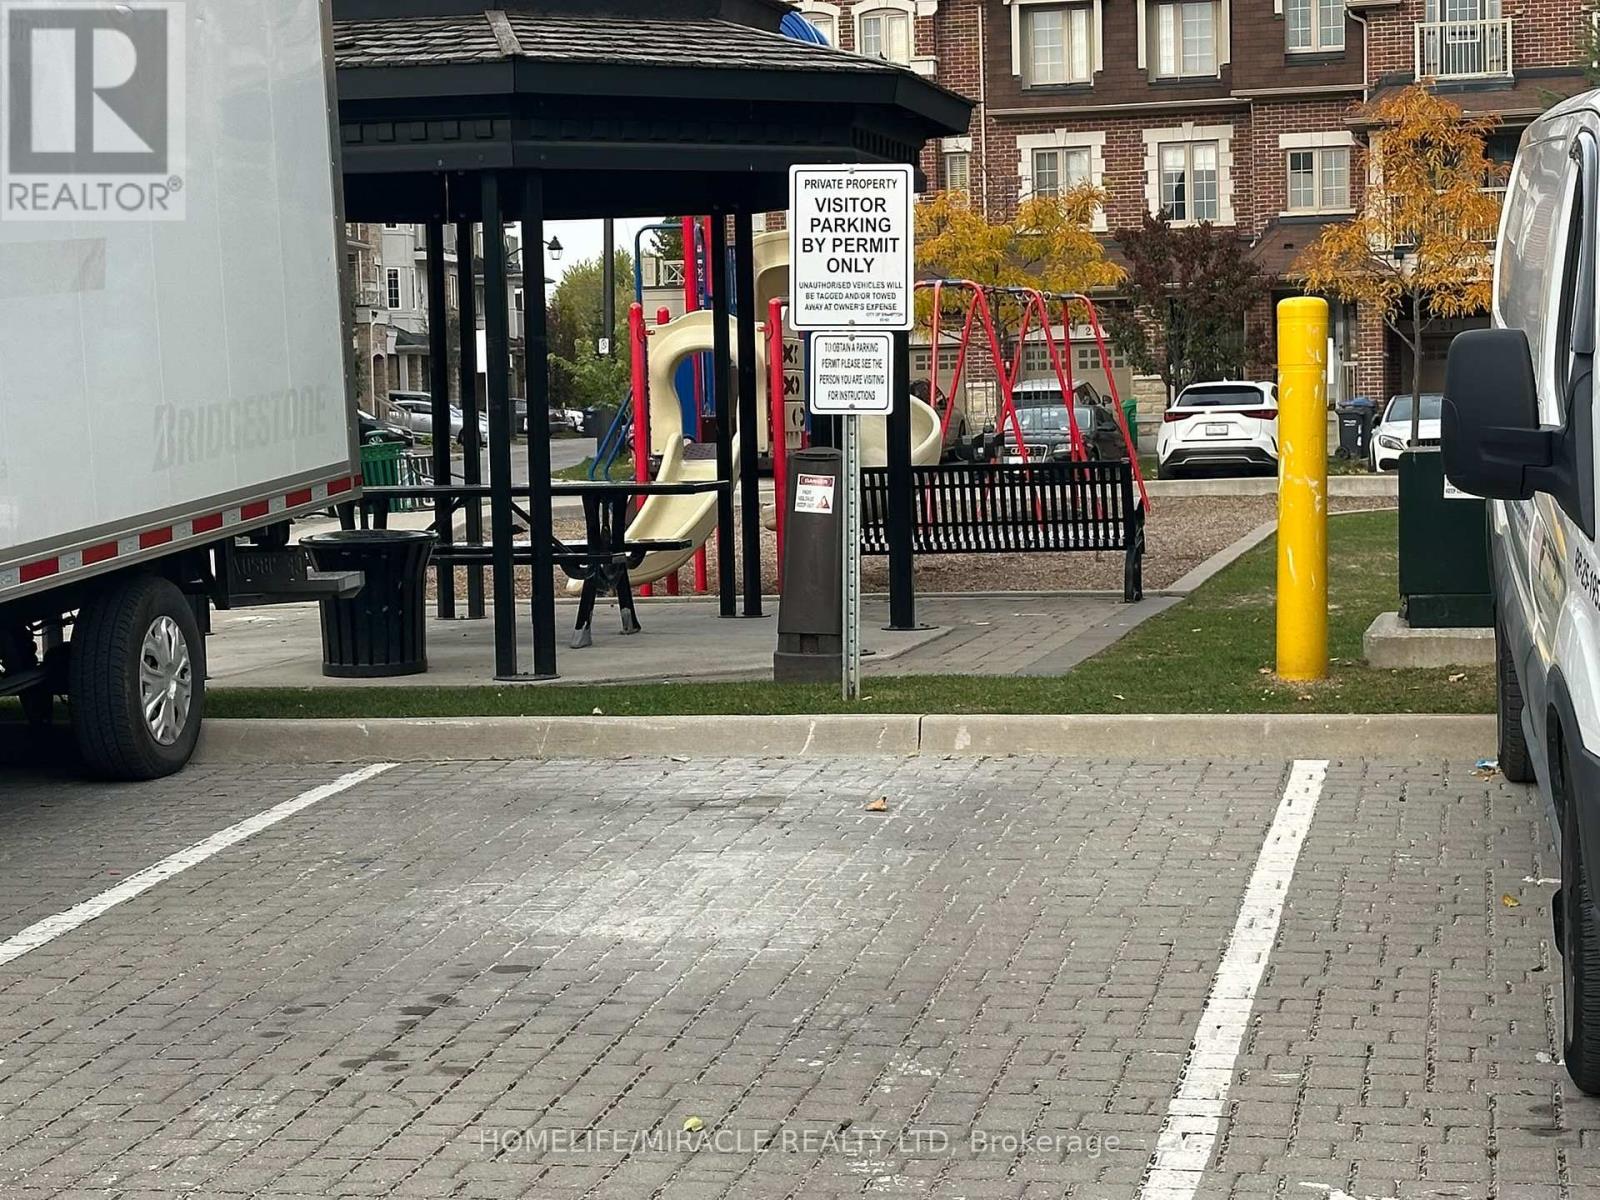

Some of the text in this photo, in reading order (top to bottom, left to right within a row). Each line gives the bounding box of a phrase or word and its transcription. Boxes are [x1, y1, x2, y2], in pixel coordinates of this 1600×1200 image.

[804, 178, 897, 189] PRIVATE PROPERTY
[814, 197, 887, 213] VISITOR
[810, 217, 891, 233] PARKING
[802, 237, 900, 253] BY PERMIT
[826, 257, 875, 273] ONLY
[798, 281, 903, 289] UNAUTHORISED VEHICLES WILL
[805, 292, 815, 300] BE
[816, 292, 844, 300] TAGGED
[872, 292, 897, 300] TOWED
[804, 303, 897, 311] AWAY AT OWNER'S EXPENSE
[824, 342, 879, 353] TO OBTAIN A PARKING
[821, 358, 883, 369] PERMIT PLEASE SEE THE
[819, 374, 885, 385] PERSON YOU ARE VISITING
[827, 390, 876, 401] FOR INSTRUCTIONS
